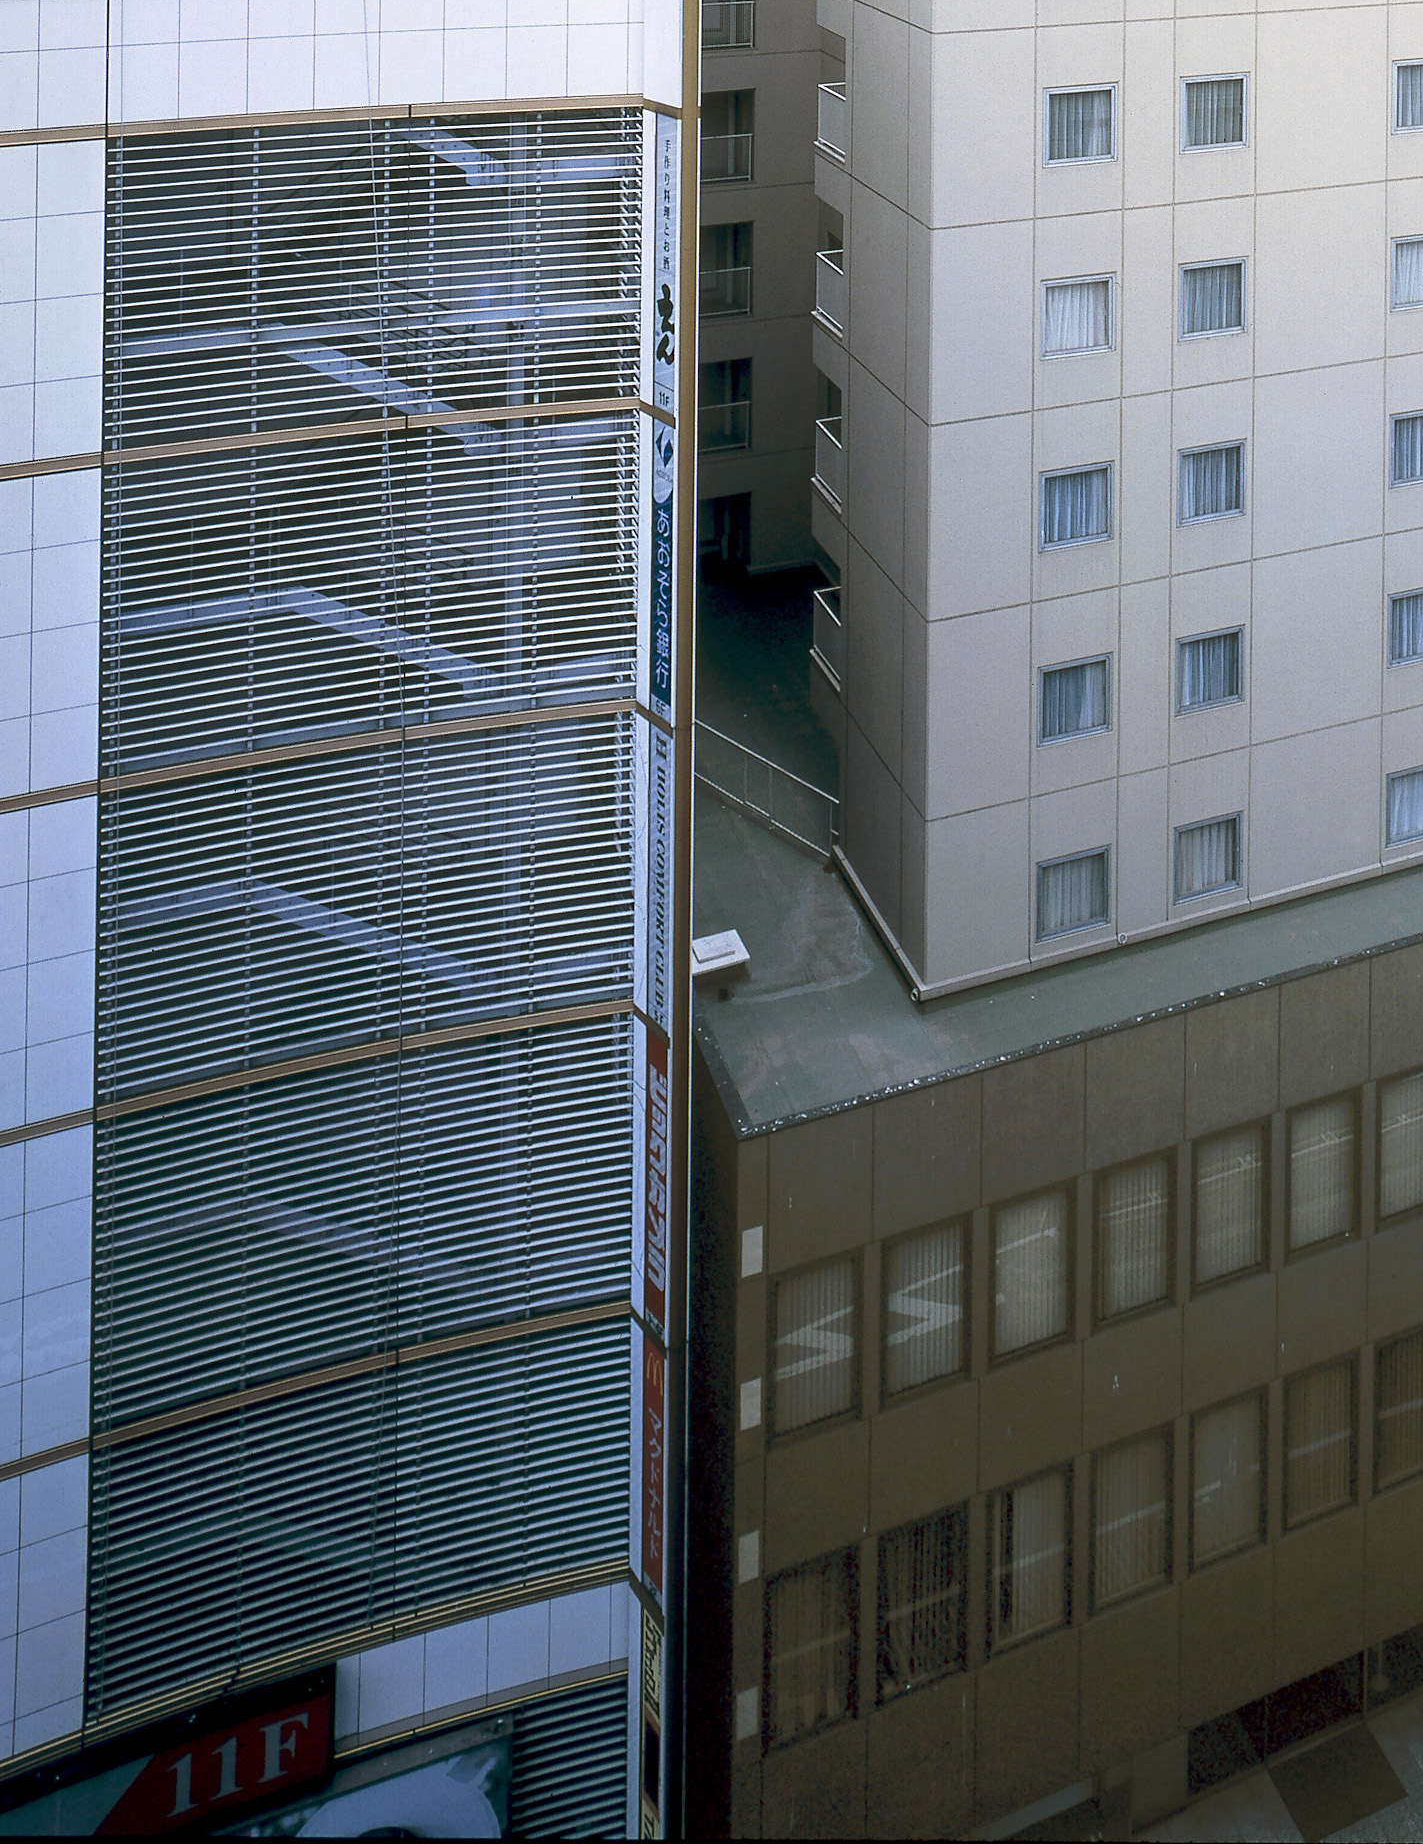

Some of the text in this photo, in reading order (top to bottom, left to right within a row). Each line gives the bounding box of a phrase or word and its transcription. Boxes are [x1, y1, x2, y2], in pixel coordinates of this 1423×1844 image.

[658, 390, 671, 408] 11F
[655, 508, 672, 690] あおぞら銀行
[655, 837, 666, 950] COMFORT
[654, 949, 665, 1009] CLUB
[647, 1406, 663, 1559] マクドナルド
[166, 1711, 310, 1819] 11F
